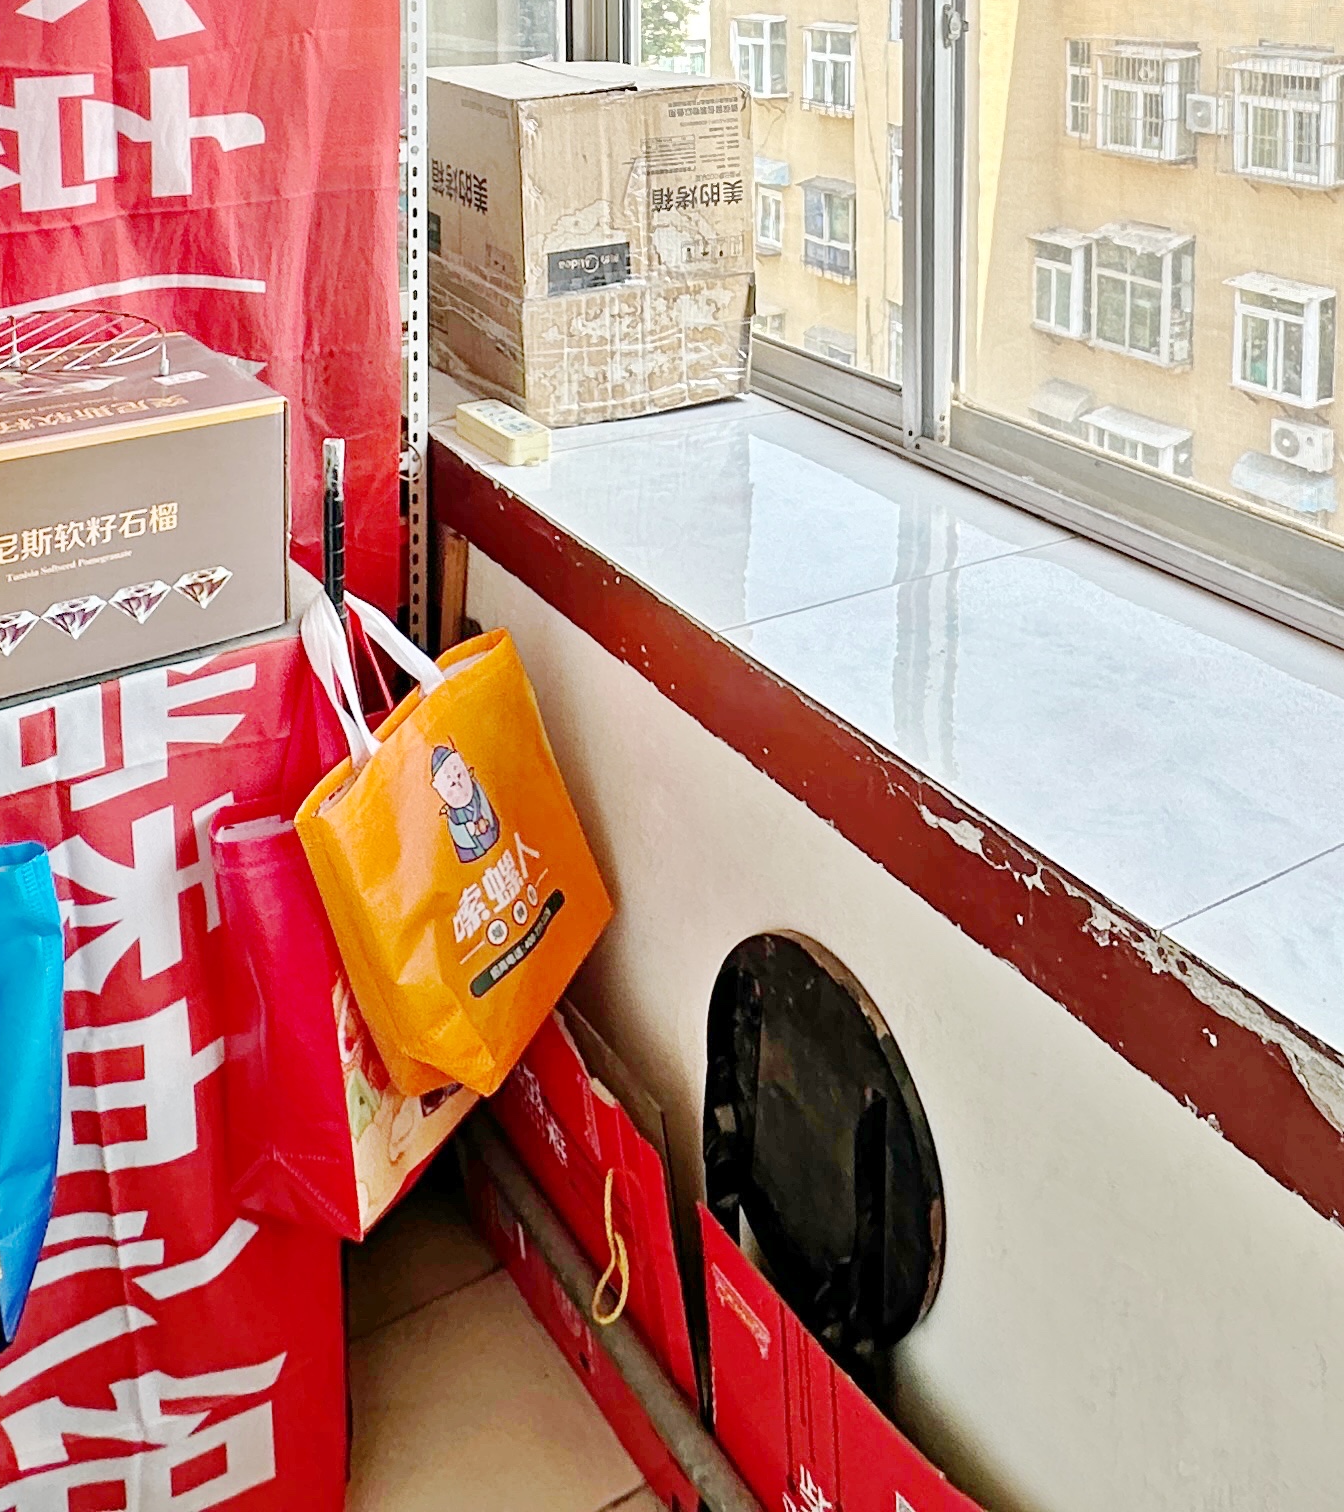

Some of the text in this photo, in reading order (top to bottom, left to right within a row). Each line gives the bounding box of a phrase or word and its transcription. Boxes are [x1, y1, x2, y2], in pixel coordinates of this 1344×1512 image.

[431, 157, 488, 215] 美的烤箱
[651, 179, 744, 213] 美的烤箱
